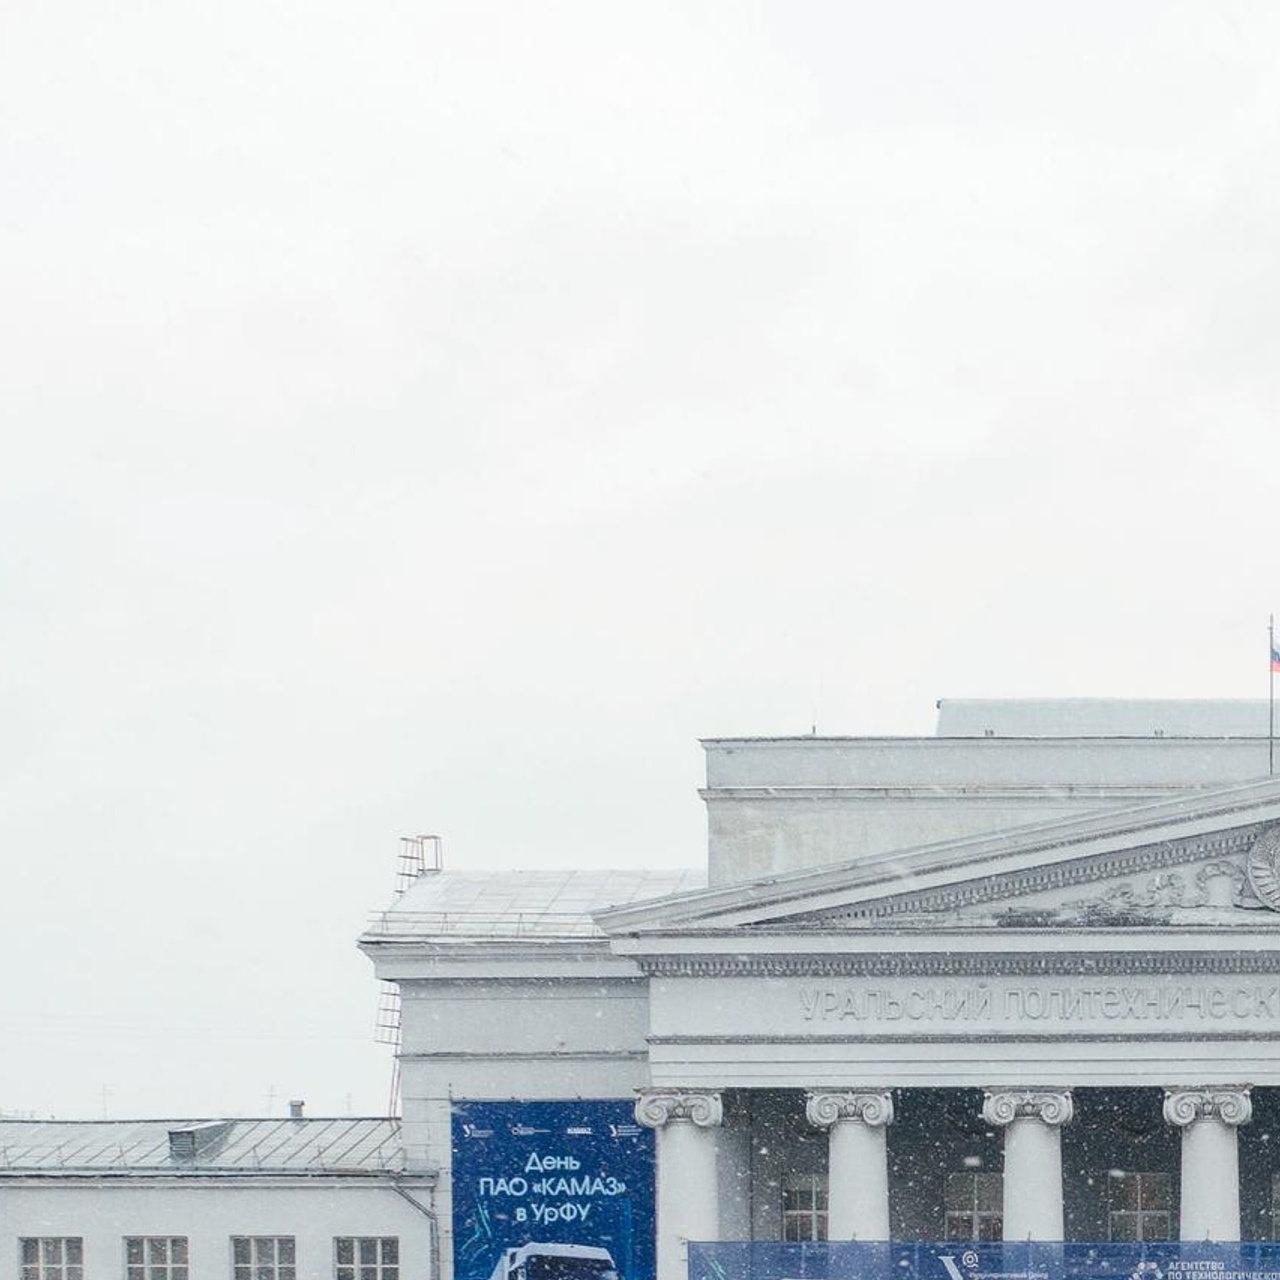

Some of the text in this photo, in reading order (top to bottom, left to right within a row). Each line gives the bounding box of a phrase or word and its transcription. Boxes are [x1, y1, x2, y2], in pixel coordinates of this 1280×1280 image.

[798, 983, 993, 1021] УРАЛЬСКИЙ
[524, 1152, 581, 1173] День
[479, 1176, 627, 1196] ПАО «КАМАЗ»
[516, 1202, 591, 1225] в УрФУ
[1167, 1261, 1225, 1271] АГЕНТСТВО
[1167, 1271, 1182, 1280] ПО
